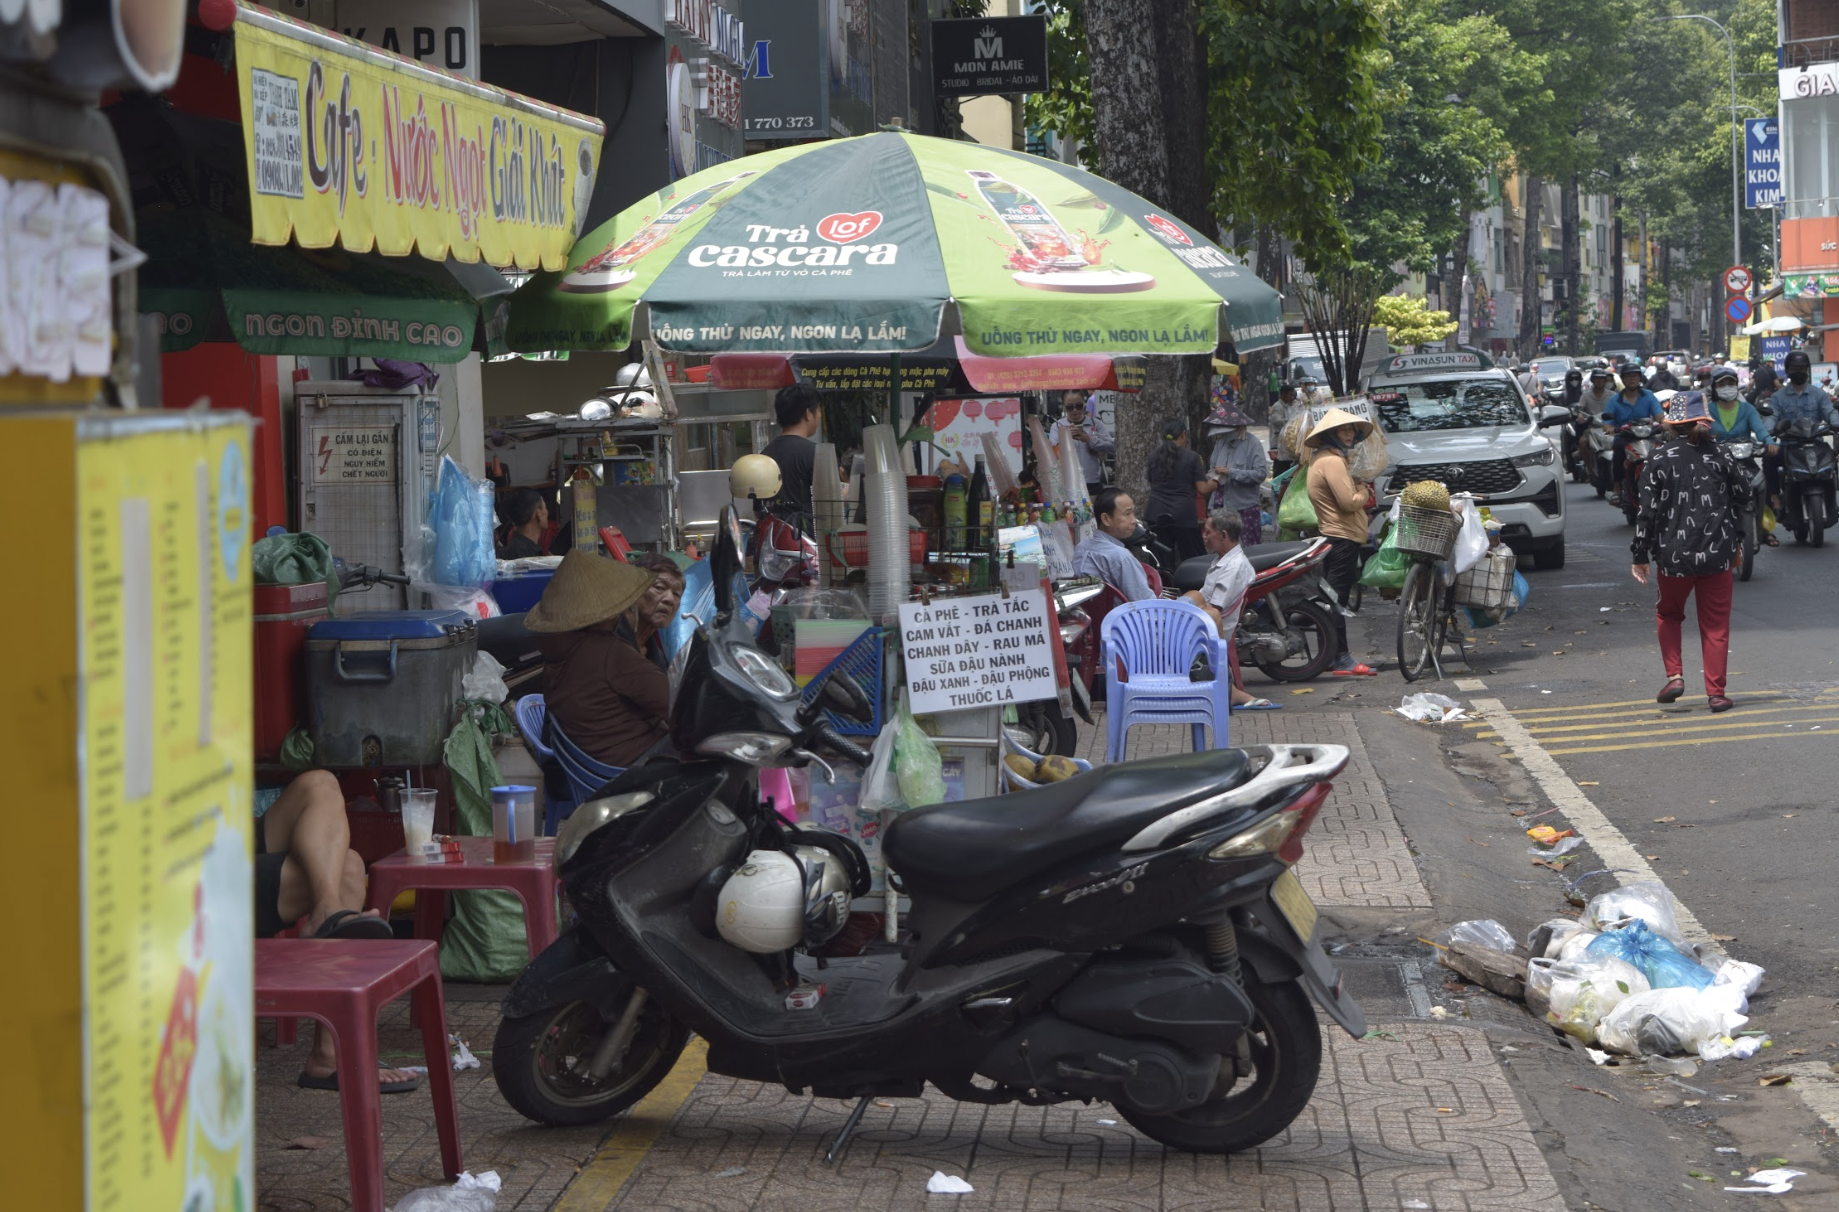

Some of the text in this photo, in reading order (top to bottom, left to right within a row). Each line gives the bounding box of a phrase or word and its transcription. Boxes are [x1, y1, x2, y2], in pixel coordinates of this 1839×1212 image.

[342, 27, 467, 68] APO
[954, 60, 1024, 73] MON AMIE
[942, 79, 969, 88] STUDIO
[976, 77, 1002, 86] BRIDAL
[1794, 74, 1836, 98] GIA
[754, 117, 783, 128] 770
[786, 116, 814, 127] 373
[306, 60, 564, 241] Cafe Nước Ngọt Giải Khát
[1753, 149, 1780, 163] NHA
[1755, 189, 1779, 203] KIM
[830, 268, 853, 276] PHÊ
[406, 321, 463, 348] CAO
[699, 322, 734, 340] THỬ
[739, 326, 785, 341] NGAY,
[791, 325, 836, 339] NGON
[841, 325, 862, 343] LẠ
[868, 320, 906, 340] LẮM!
[982, 323, 1209, 347] UỐNG THỬ NGAY, NGON LẠ LẮM!
[1766, 340, 1786, 348] NHA
[1411, 355, 1477, 366] VINASUN TAXI
[860, 366, 868, 375] Cà
[869, 366, 880, 375] Phê
[936, 367, 949, 377] máy
[924, 379, 935, 388] Phê
[335, 431, 353, 445] CẤM
[356, 434, 369, 447] LẠI
[347, 448, 358, 457] CÓ
[344, 460, 364, 468] NGUY
[342, 468, 388, 478] CHẾT NGƯỜI
[914, 596, 1029, 623] CÀ PHÊ TRÀ TẮC
[906, 616, 1042, 642] CAM VẮT ĐÁ CHANH
[908, 630, 1046, 660] CHANH DÂY RAU MÁ
[930, 653, 1025, 675] SỮA ĐẬU NÀNH
[913, 665, 1050, 694] ĐẬU XANH ĐẬU PHỘNG
[949, 685, 1014, 706] THUỐC LÁ
